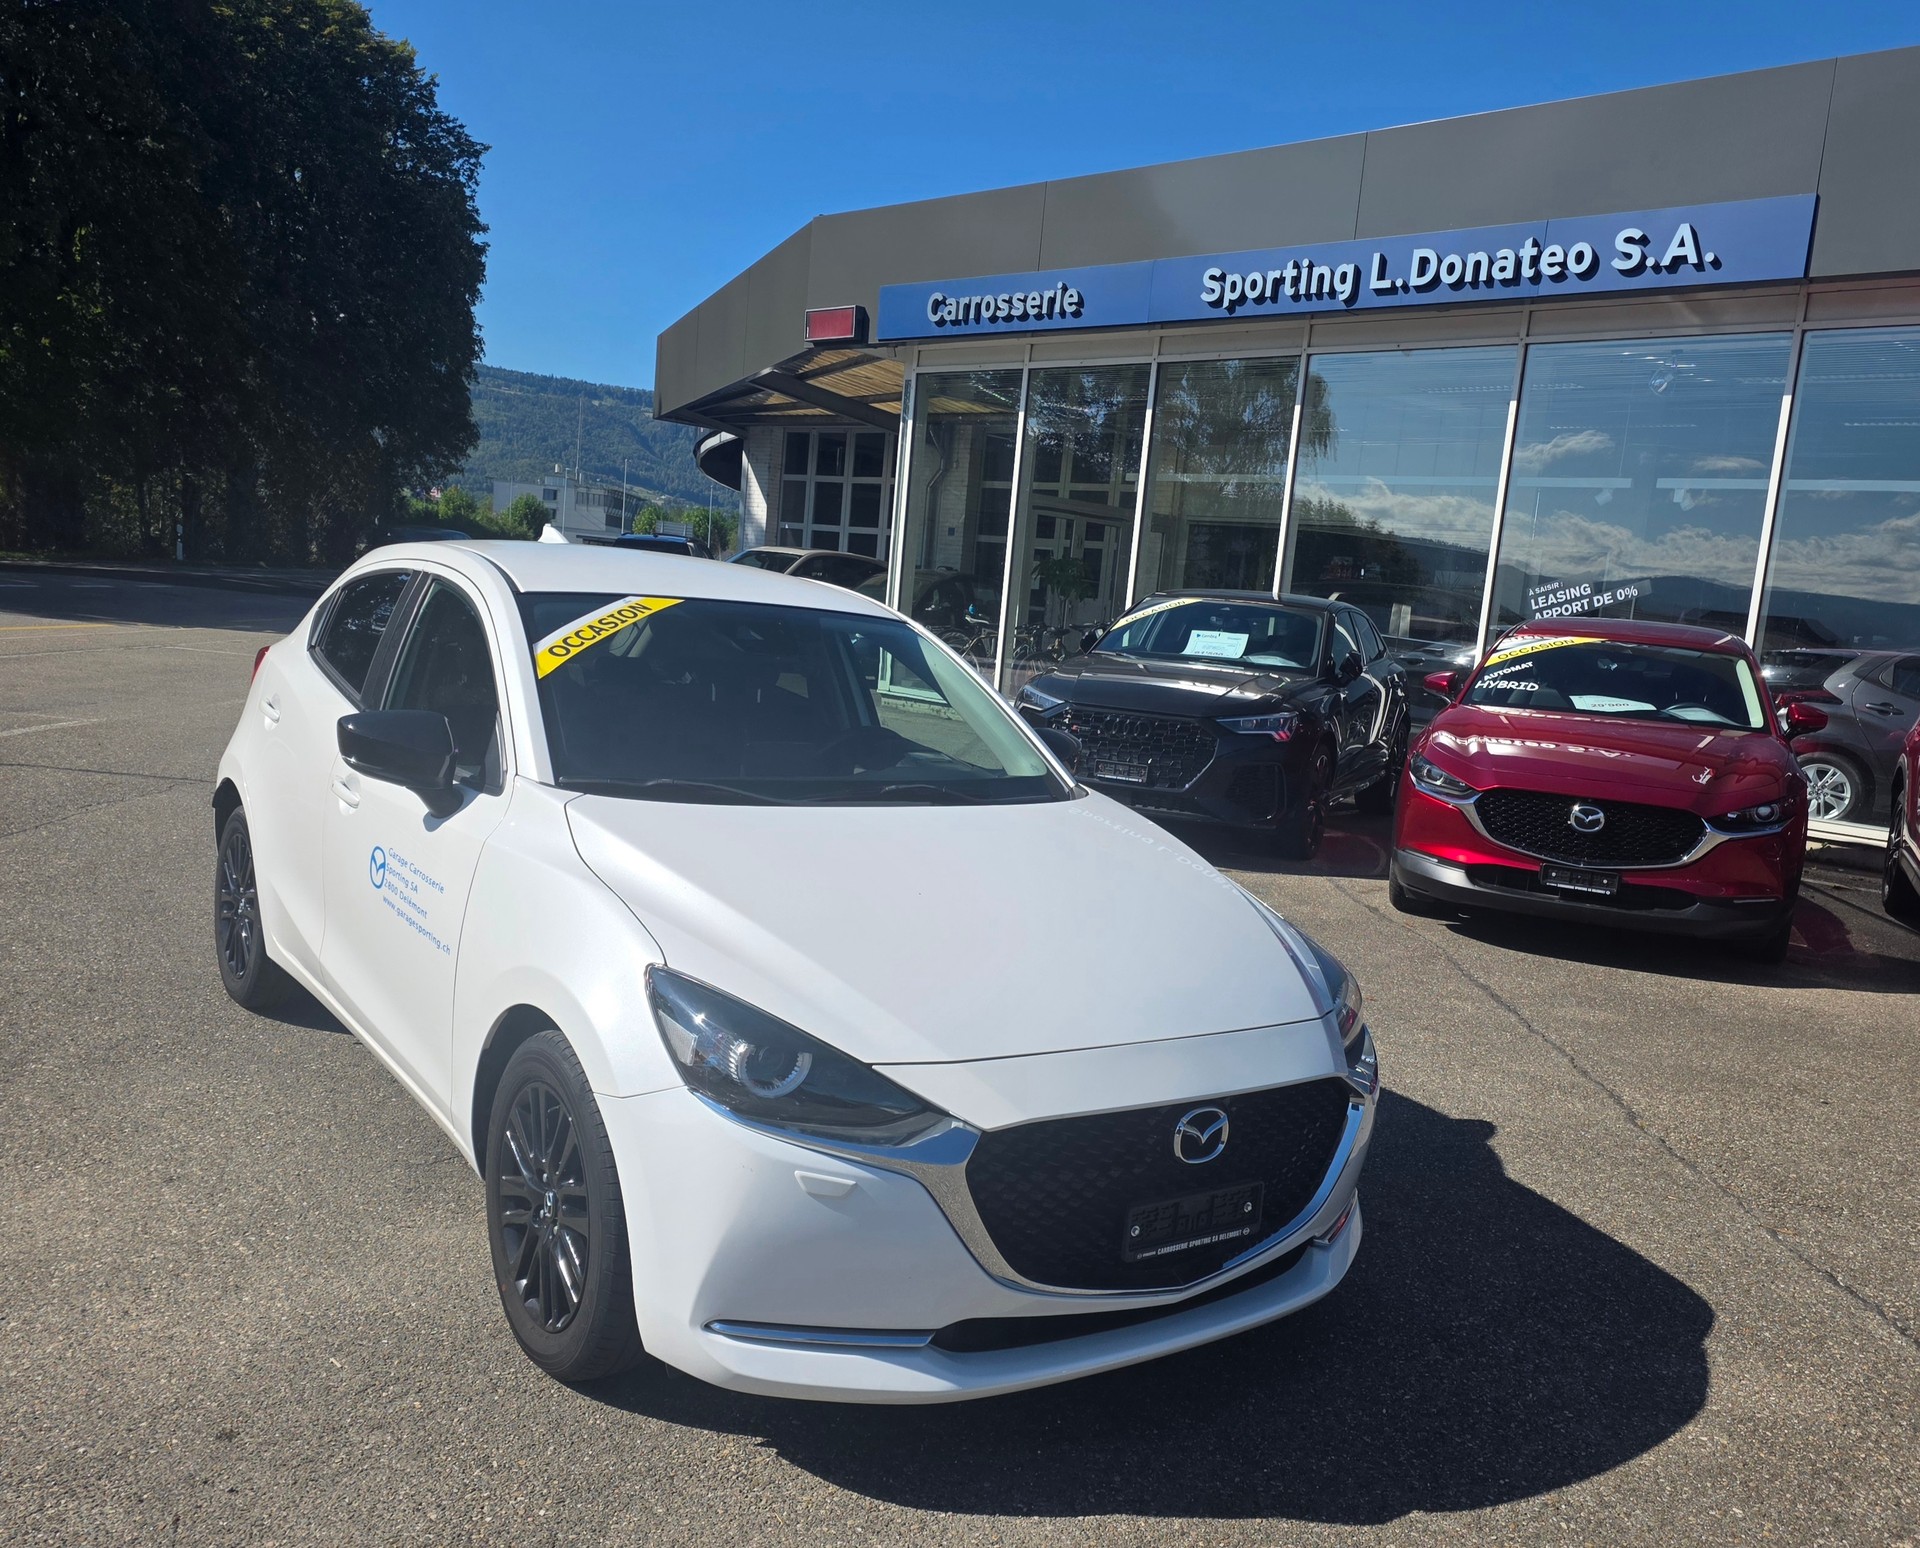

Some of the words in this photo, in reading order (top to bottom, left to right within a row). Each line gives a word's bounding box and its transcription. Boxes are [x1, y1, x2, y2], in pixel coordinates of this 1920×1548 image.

[1200, 258, 1356, 309] Sporting
[1610, 222, 1716, 271] S.A.
[927, 281, 1079, 323] Carrosserie
[1530, 583, 1592, 610] LEASING
[1535, 581, 1560, 594] SAISIR
[1593, 592, 1614, 608] DE
[1616, 585, 1639, 601] 0%
[547, 602, 653, 658] OCCASION
[1497, 639, 1575, 660] OCCASION
[1474, 680, 1539, 691] HYBRID
[1483, 661, 1533, 681] AUTOMAT
[386, 863, 409, 889] Sporting
[409, 882, 418, 894] SA
[388, 847, 408, 869] Garage
[409, 862, 445, 895] Carrosserie
[384, 878, 398, 896] 2800
[399, 890, 428, 919] Delémont
[382, 895, 451, 956] www.garagesporting.ch
[1157, 1243, 1189, 1255] CARROSSERIE
[1188, 1237, 1212, 1248] SPORTING
